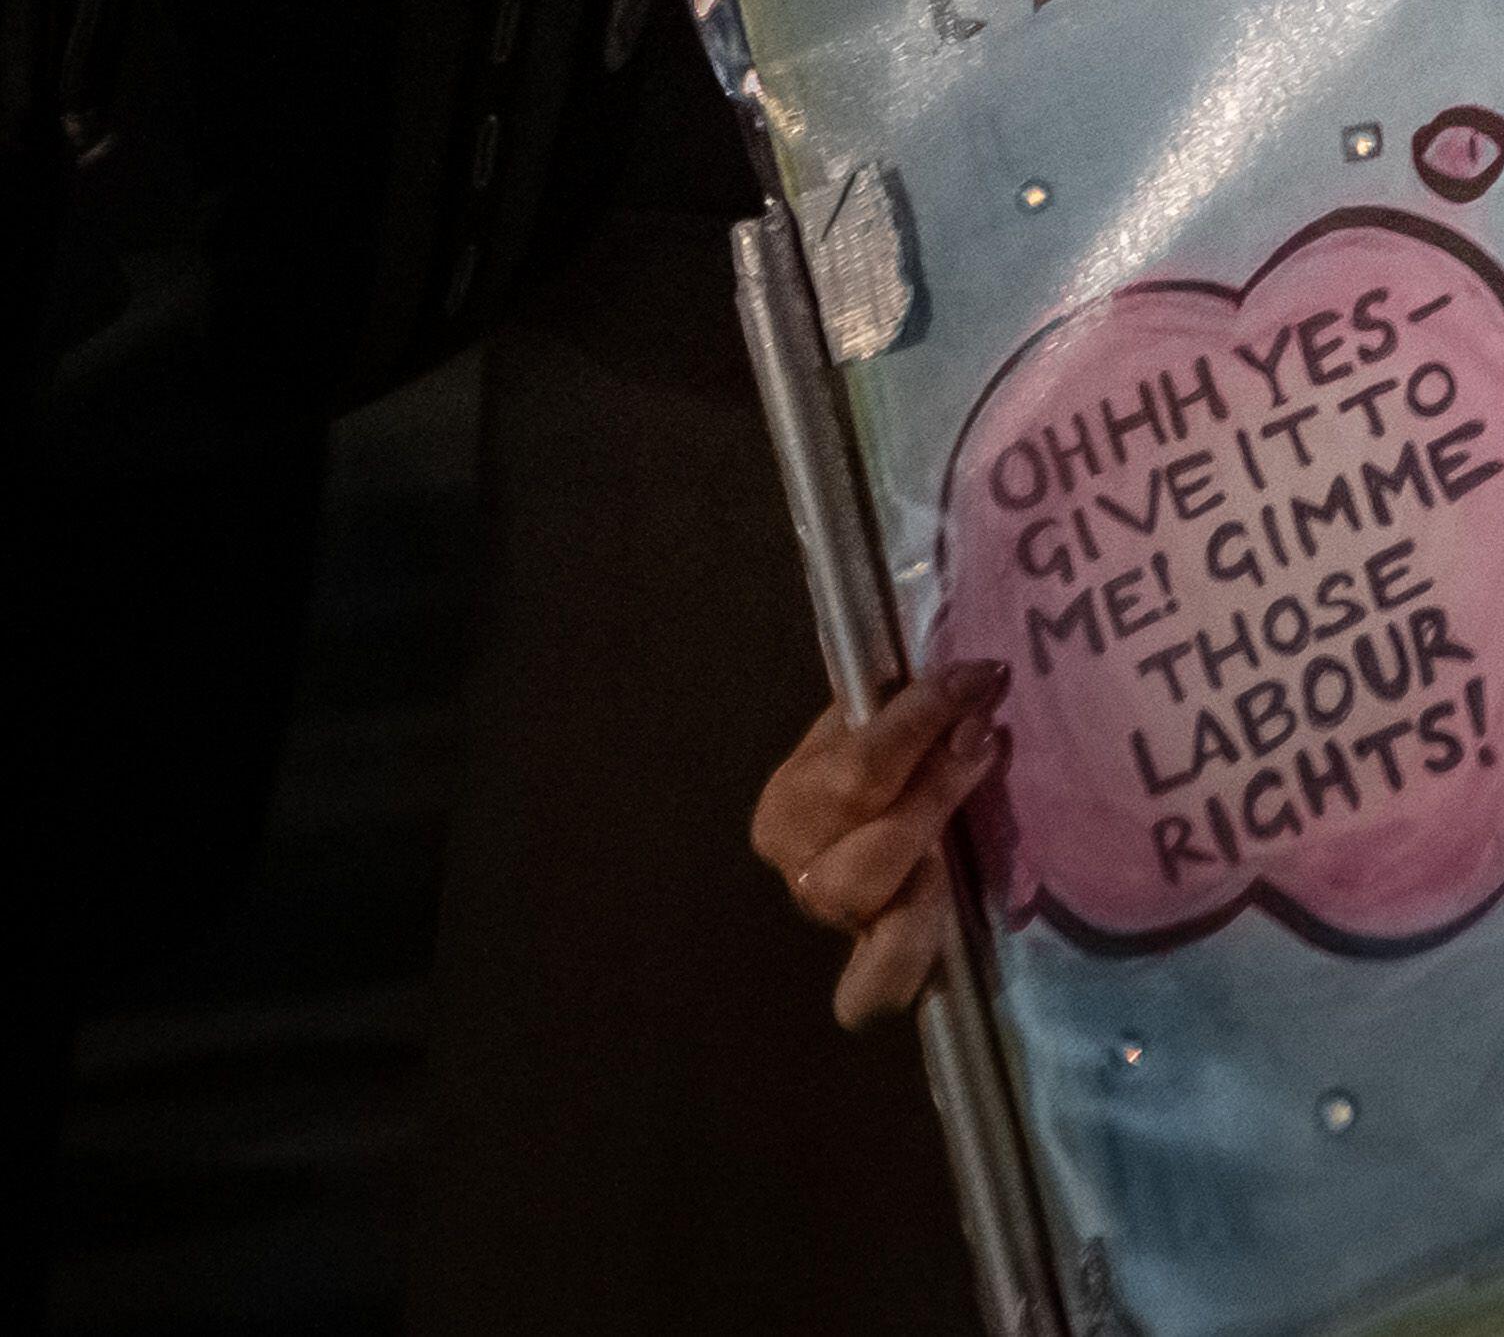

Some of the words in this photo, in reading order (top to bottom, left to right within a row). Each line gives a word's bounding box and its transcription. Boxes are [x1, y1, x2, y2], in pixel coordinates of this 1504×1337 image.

[989, 357, 1230, 511] OHHH
[1016, 450, 1223, 582] GIVE
[1237, 408, 1320, 491] IT
[1339, 362, 1456, 436] TO
[1023, 552, 1180, 675] ME!
[1207, 419, 1504, 587] GIMME
[1137, 539, 1435, 703] THOSE
[1128, 606, 1476, 798] LABOUR
[1151, 679, 1497, 885] RIGHTS!
